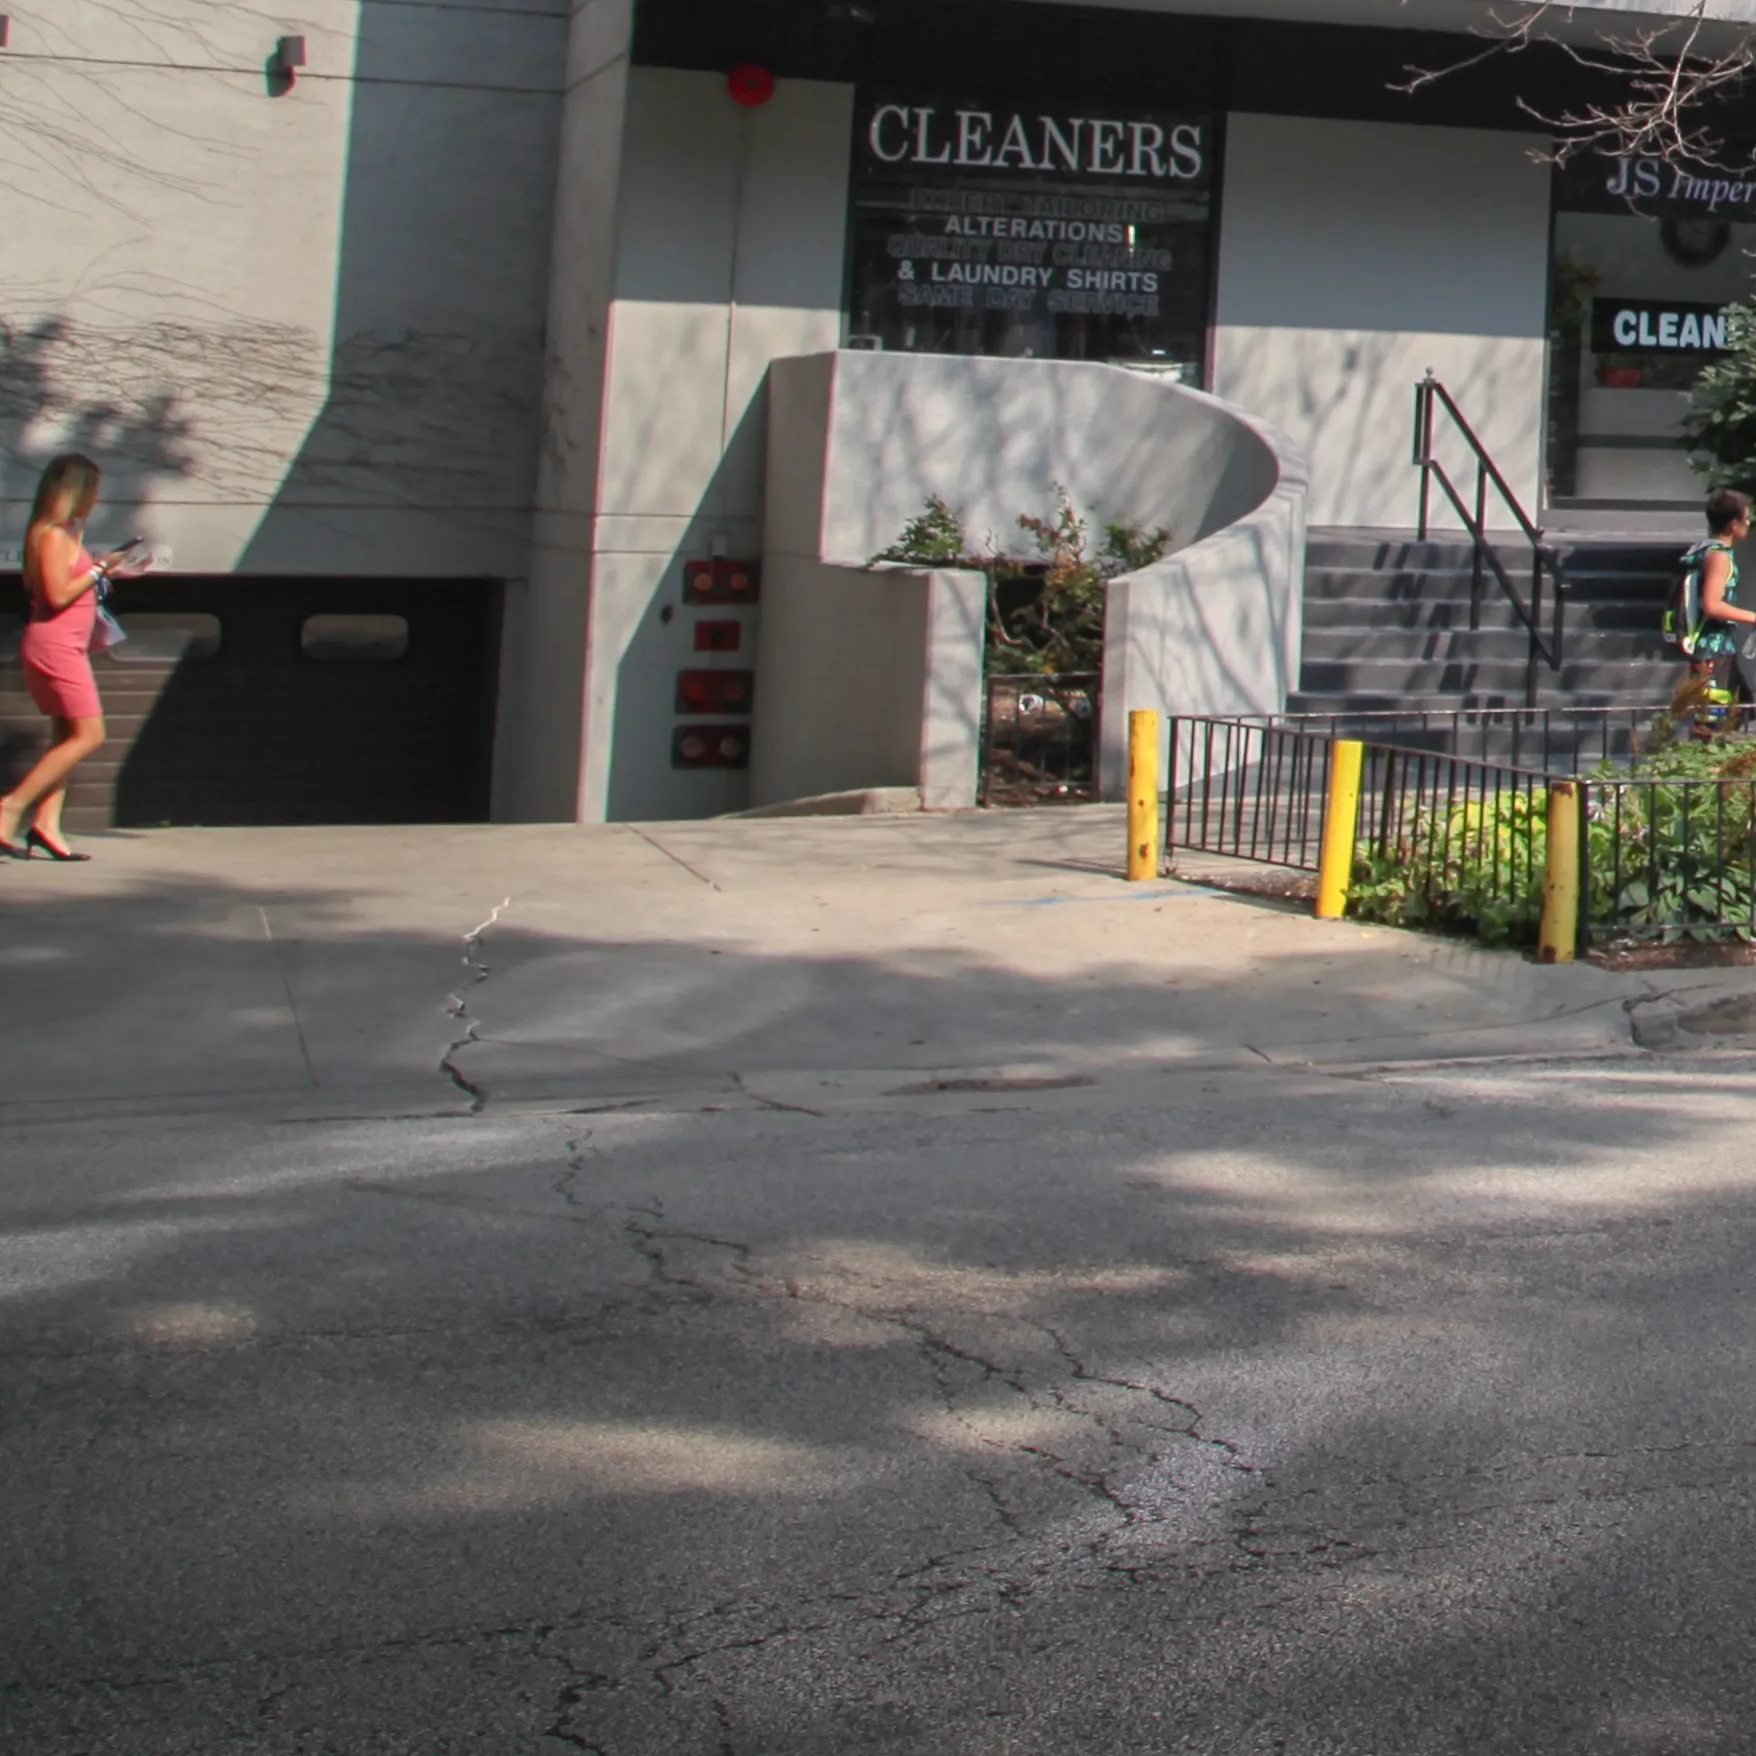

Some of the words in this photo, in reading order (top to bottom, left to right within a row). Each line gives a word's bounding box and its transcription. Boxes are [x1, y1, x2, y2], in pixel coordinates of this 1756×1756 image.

[869, 104, 1202, 179] CLEANERS
[1606, 156, 1661, 196] JS
[1022, 195, 1164, 223] TAILORING
[944, 215, 1123, 244] ALTERATIONS
[886, 234, 994, 261] QUALITY
[997, 240, 1048, 265] DRY
[1053, 243, 1173, 272] CLEANING
[896, 259, 916, 281] &
[931, 261, 1053, 287] LAUNDRY
[1066, 267, 1160, 293] SHIRTS
[896, 283, 975, 308] SAME
[985, 286, 1038, 311] DAY
[1046, 288, 1160, 317] SERVICE
